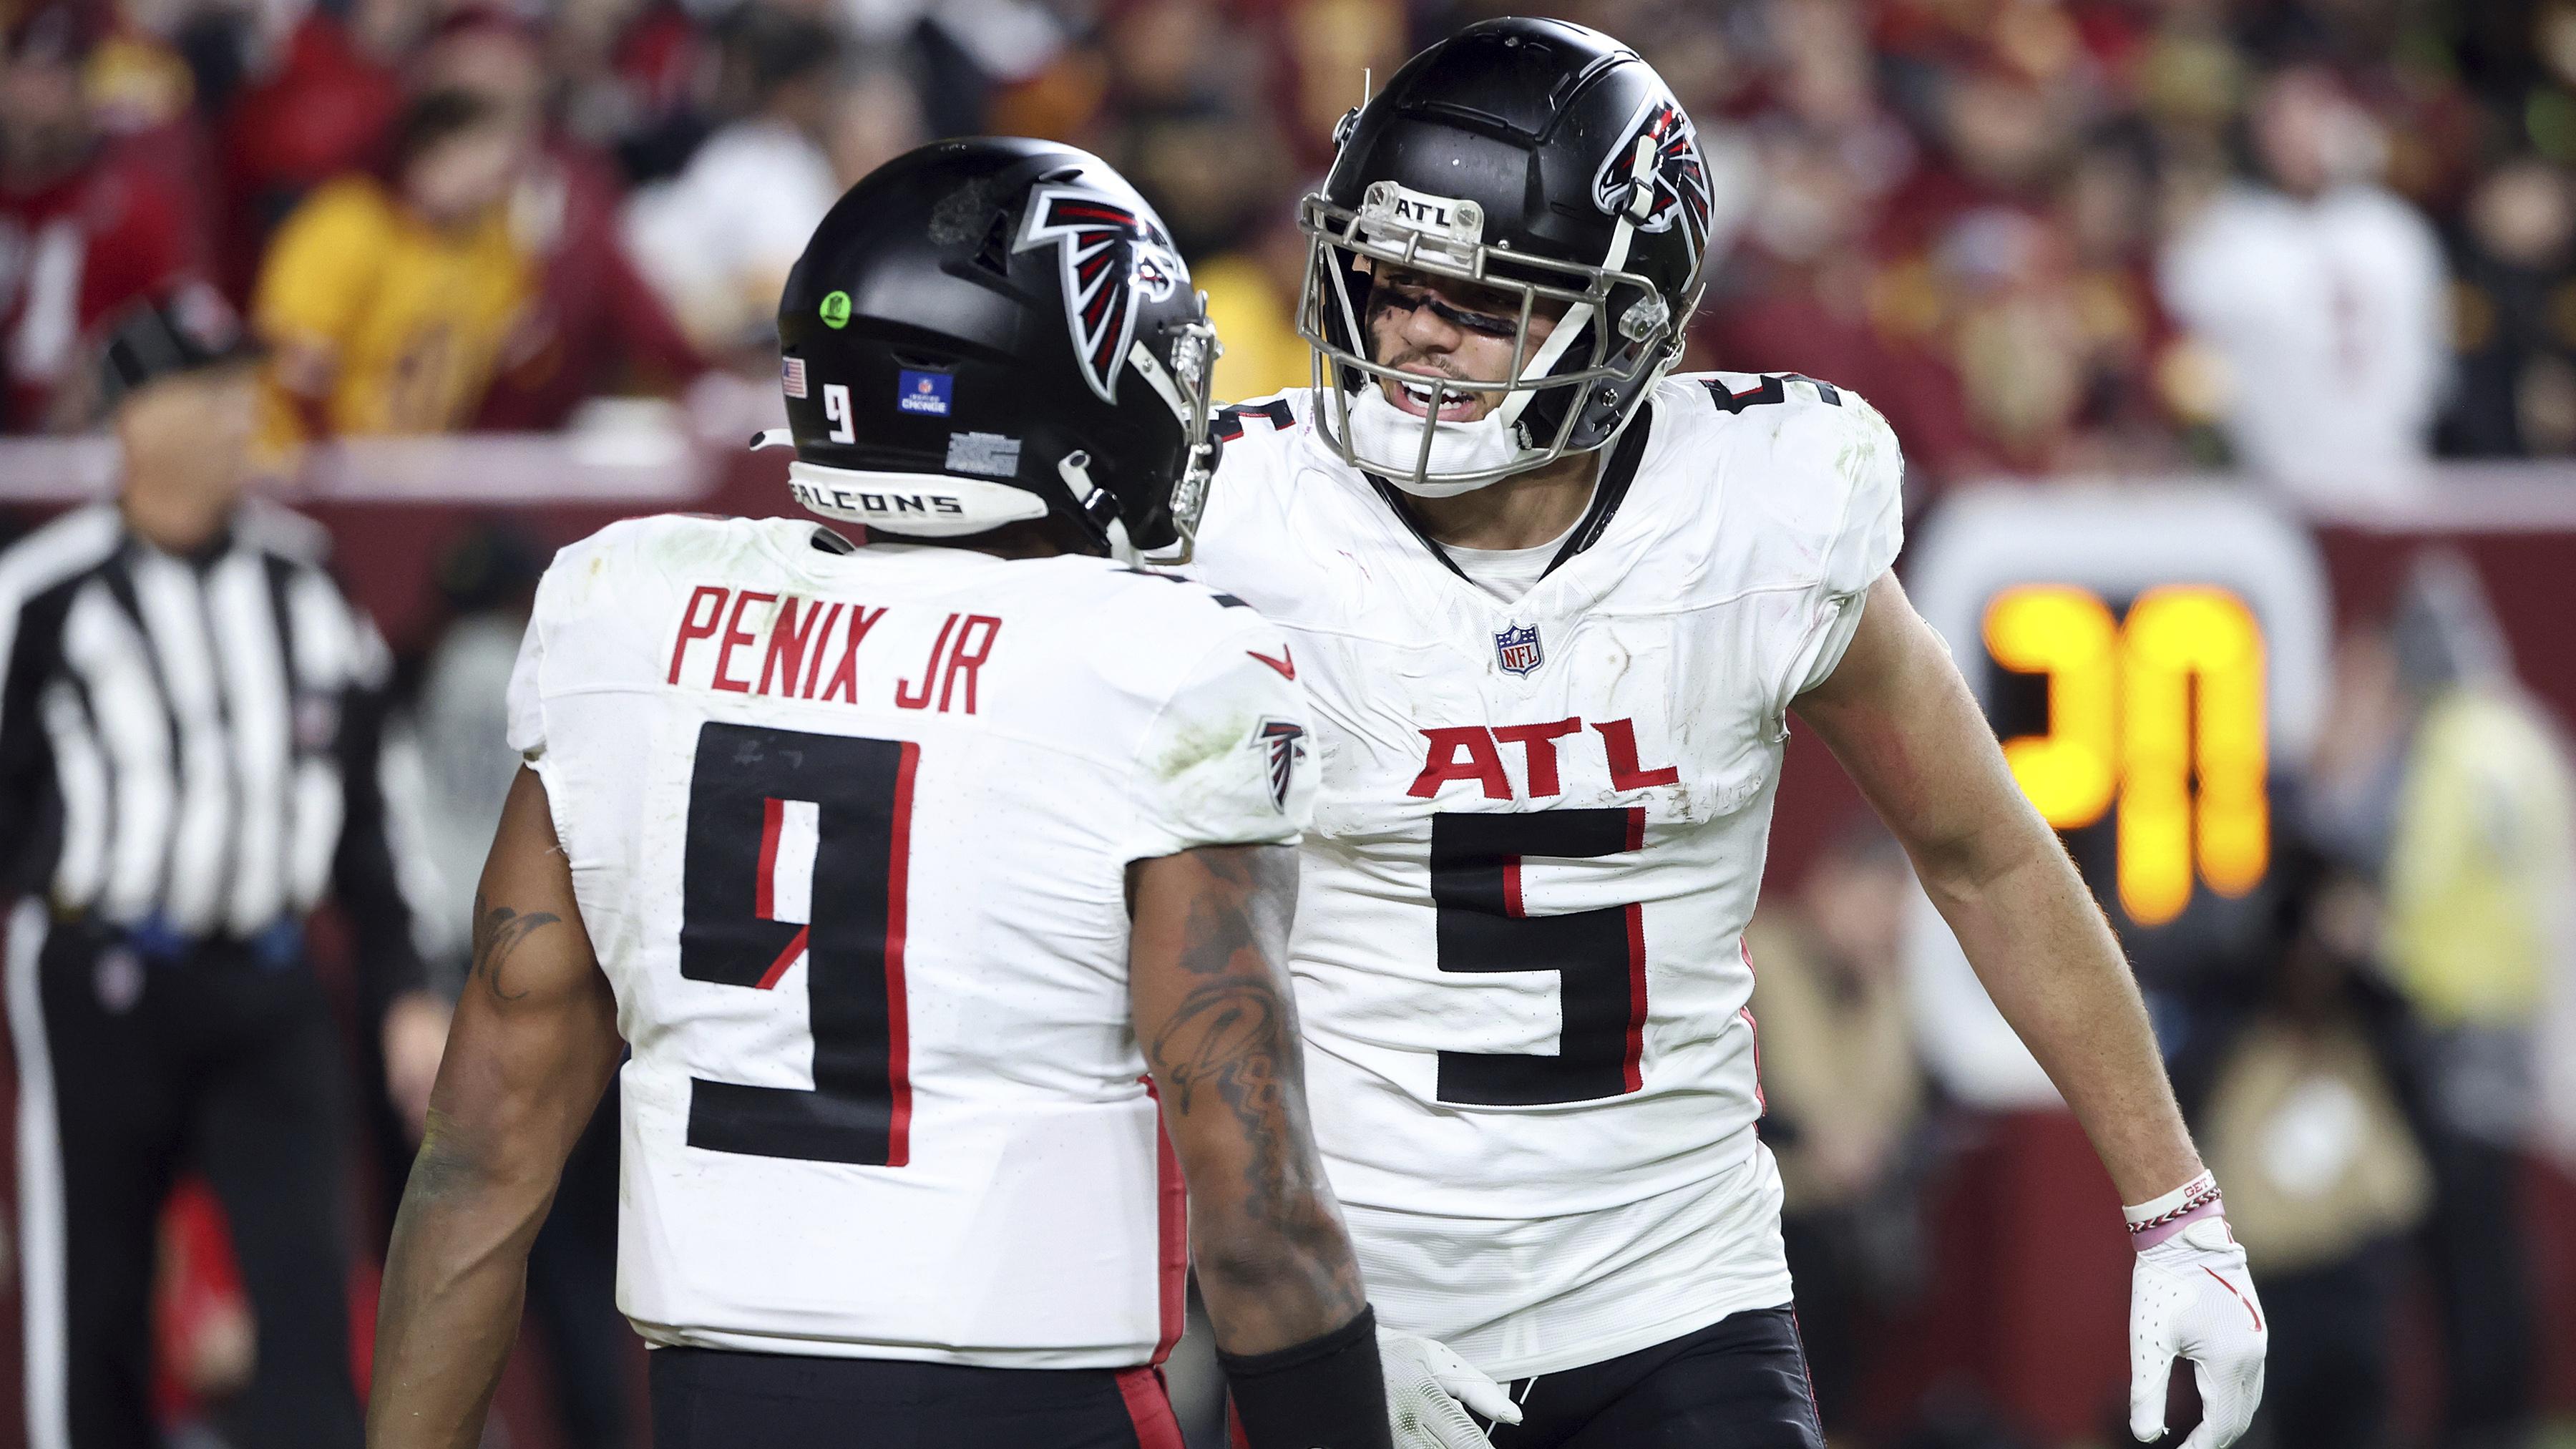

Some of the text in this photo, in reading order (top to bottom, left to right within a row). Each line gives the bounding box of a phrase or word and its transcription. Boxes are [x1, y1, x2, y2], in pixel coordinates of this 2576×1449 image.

[1395, 199, 1450, 227] ATL
[823, 384, 857, 445] 9
[789, 483, 963, 514] FALCONS
[668, 585, 1002, 715] PENIX JR
[1502, 644, 1538, 669] NFL
[1406, 716, 1680, 801] ATL
[680, 721, 921, 1167] 9
[1430, 806, 1648, 1107] 5
[2184, 1178, 2208, 1198] GET
